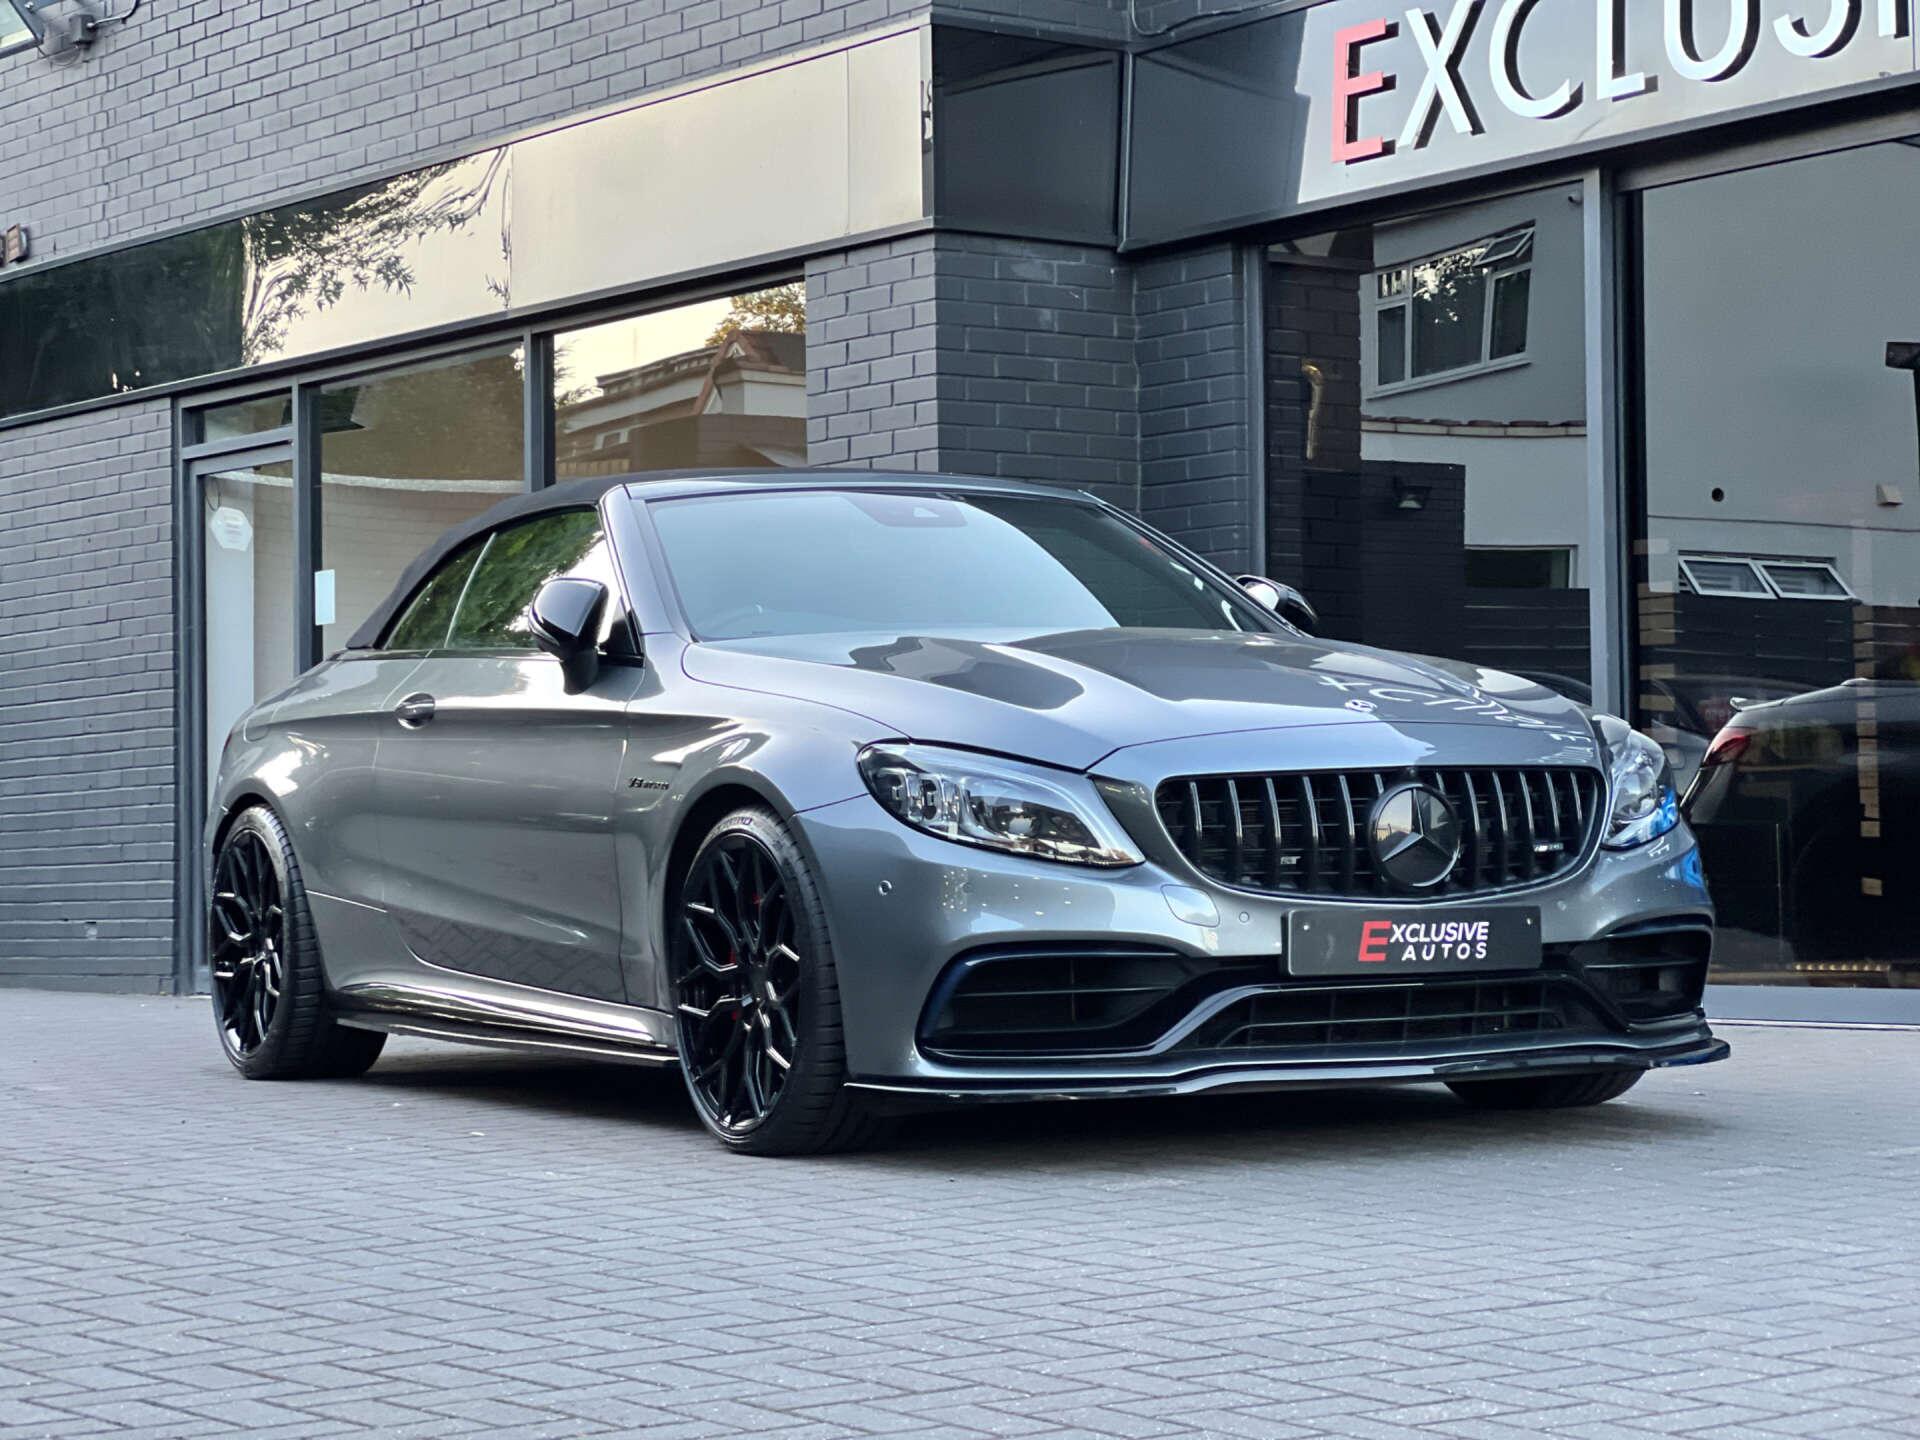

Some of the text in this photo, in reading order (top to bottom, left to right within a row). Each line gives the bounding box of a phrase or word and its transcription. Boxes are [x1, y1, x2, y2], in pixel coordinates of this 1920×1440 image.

[1331, 0, 1909, 163] EXCLU
[1358, 920, 1489, 962] EXCLUSIVE
[1401, 942, 1487, 961] AUTOS
